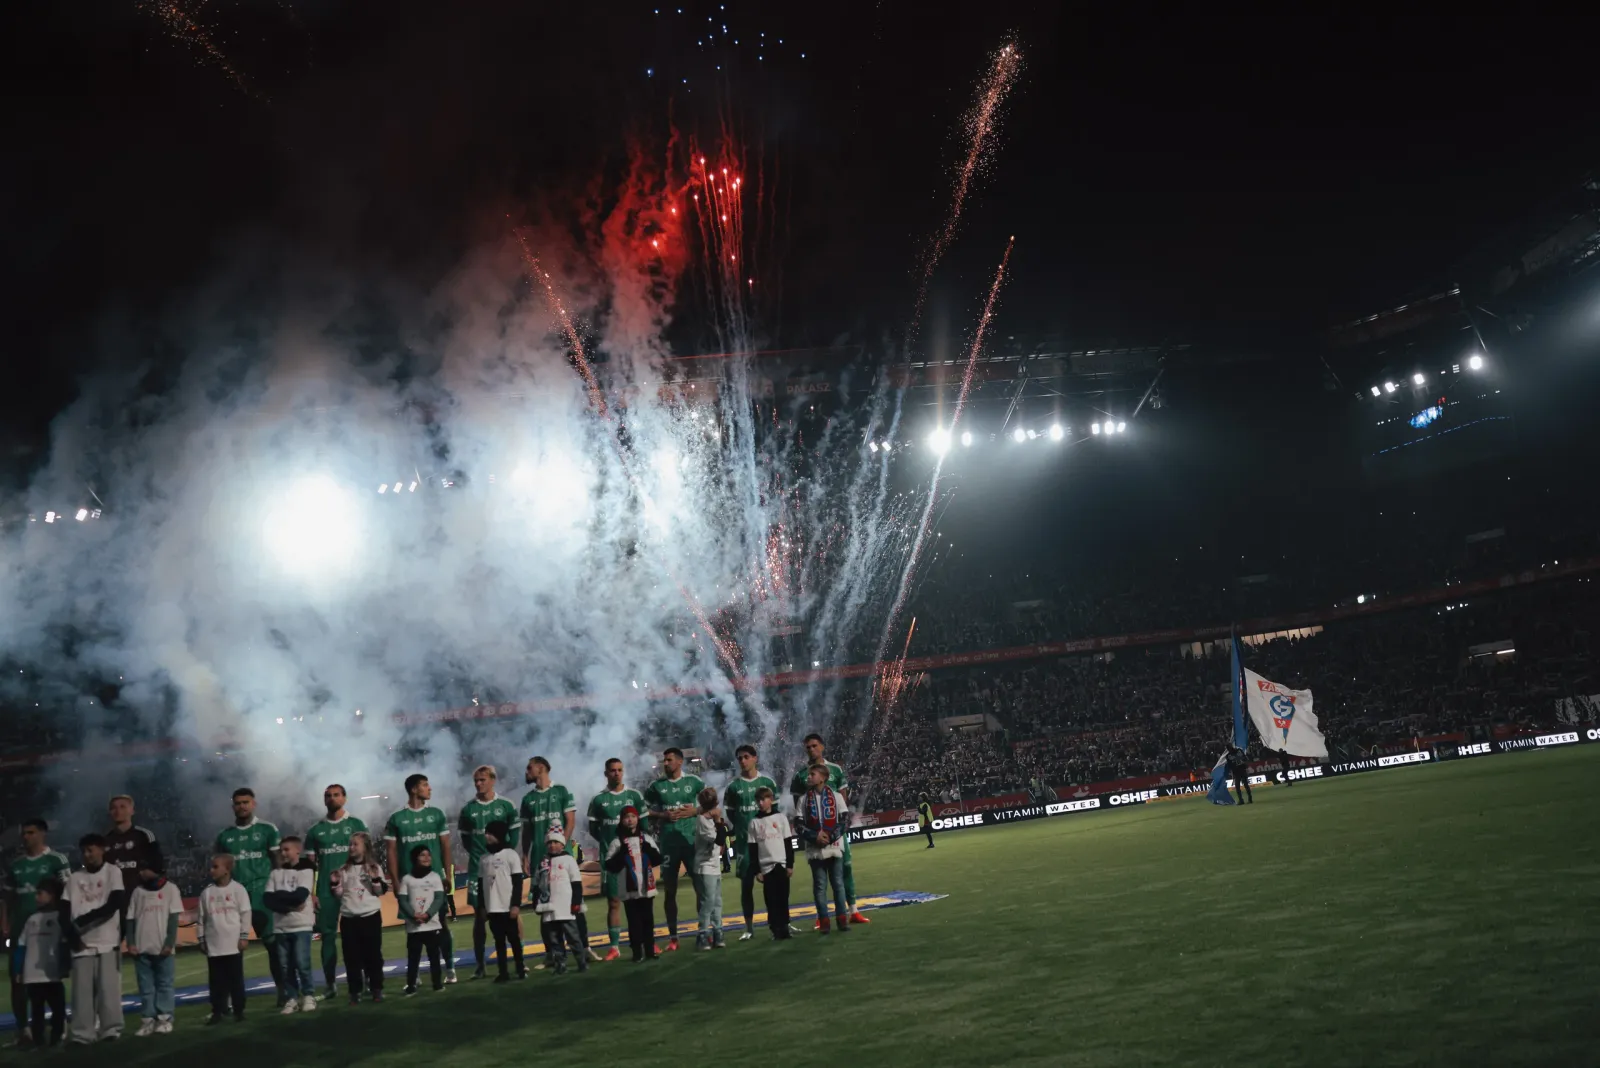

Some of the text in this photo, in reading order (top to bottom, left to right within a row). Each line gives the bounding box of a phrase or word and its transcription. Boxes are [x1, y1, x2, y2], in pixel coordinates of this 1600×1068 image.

[1498, 738, 1535, 750] VITAMIN
[1538, 734, 1575, 744] WATER
[1331, 759, 1377, 773] VITAMIN
[1108, 789, 1158, 806] OSHEE
[931, 800, 1096, 830] OSHEE VITAMIN WATER
[867, 825, 916, 837] WATER
